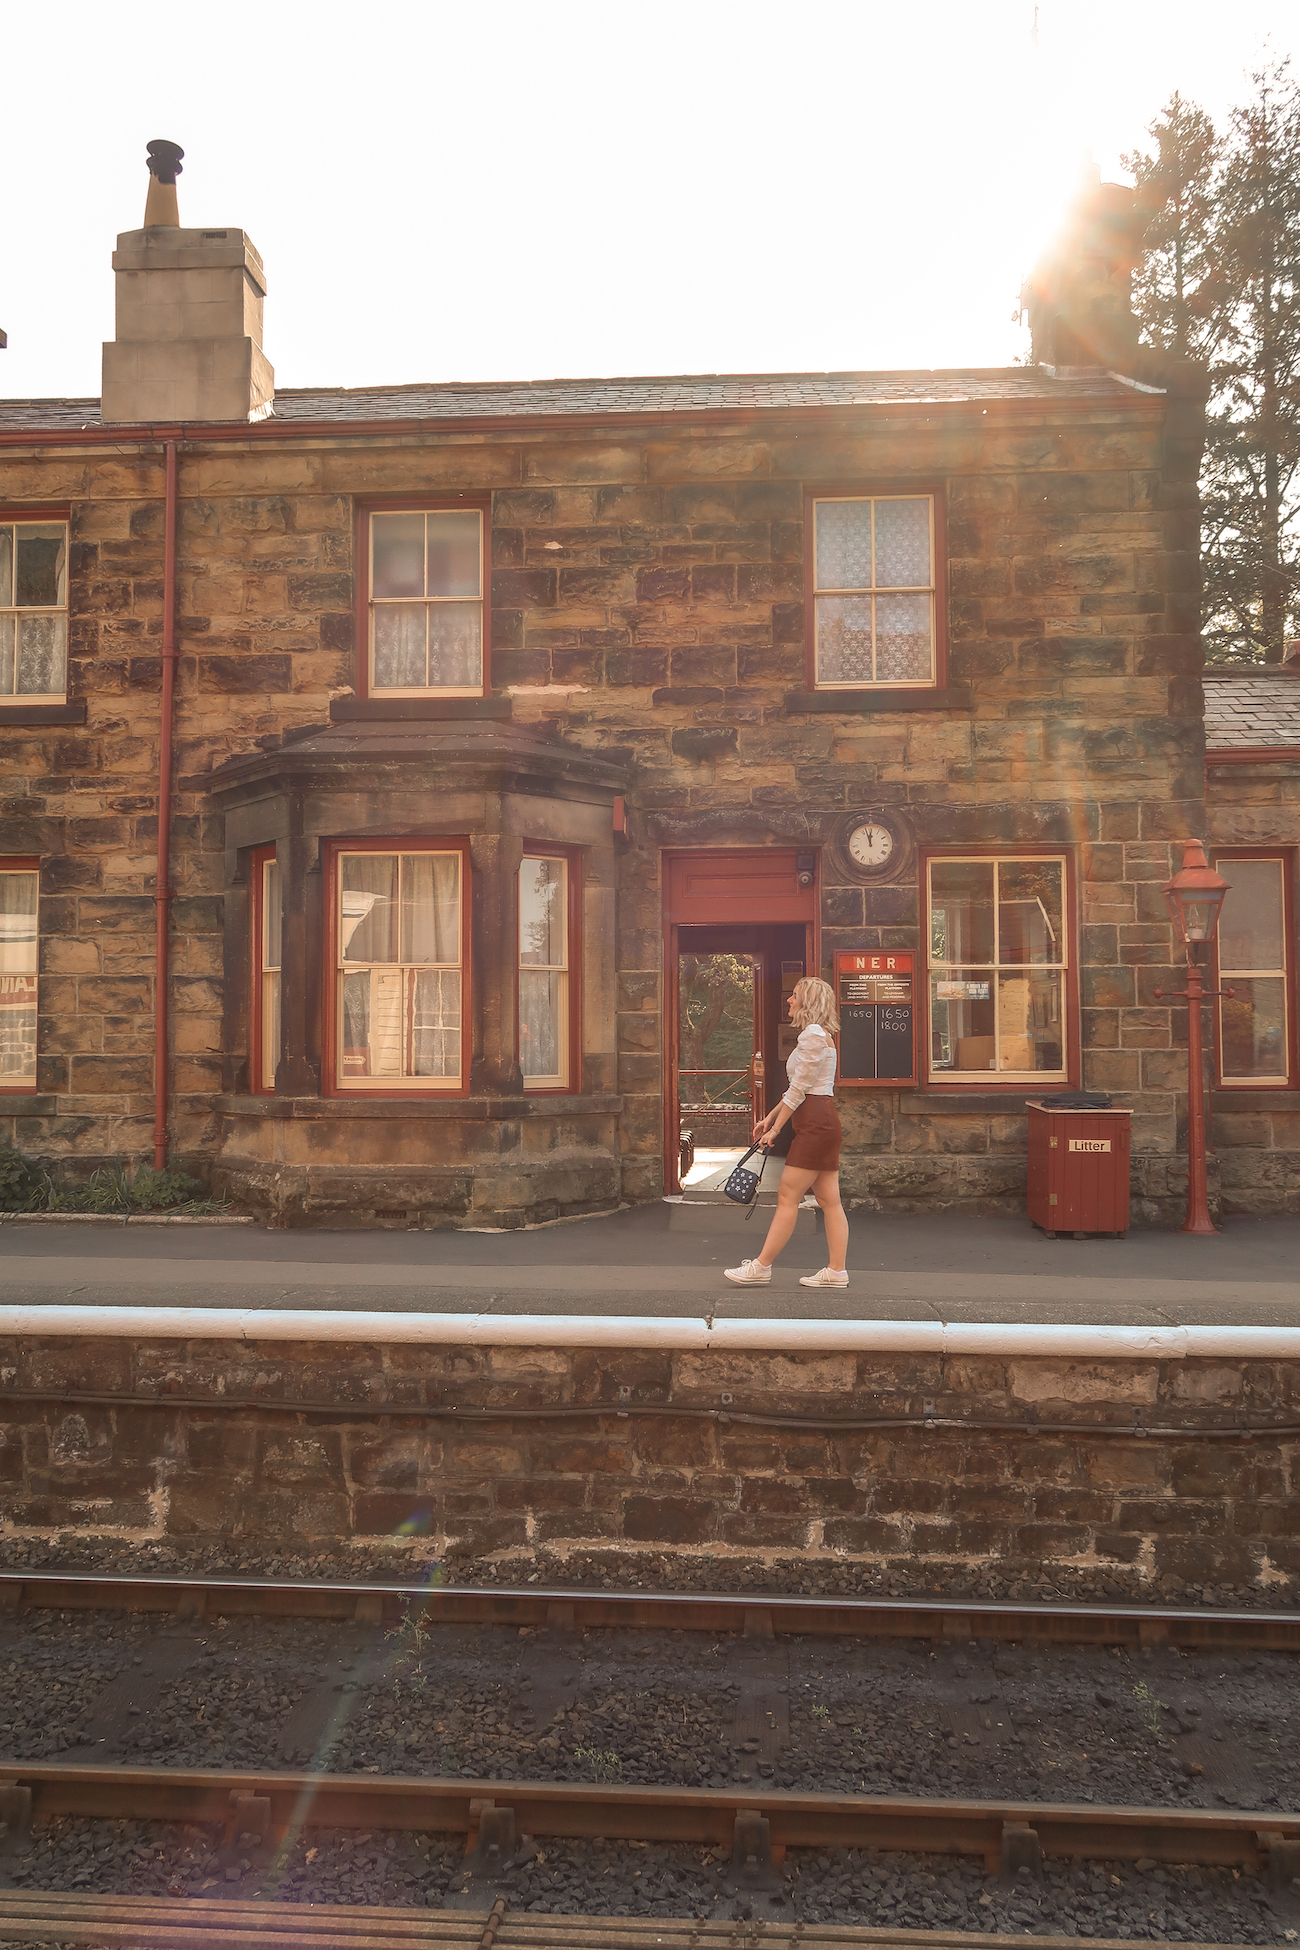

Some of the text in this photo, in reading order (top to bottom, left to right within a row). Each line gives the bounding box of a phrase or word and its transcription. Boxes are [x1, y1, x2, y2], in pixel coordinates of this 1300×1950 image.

[849, 1010, 873, 1018] 1650
[881, 1008, 910, 1019] 1650
[1074, 1141, 1104, 1150] Litter
